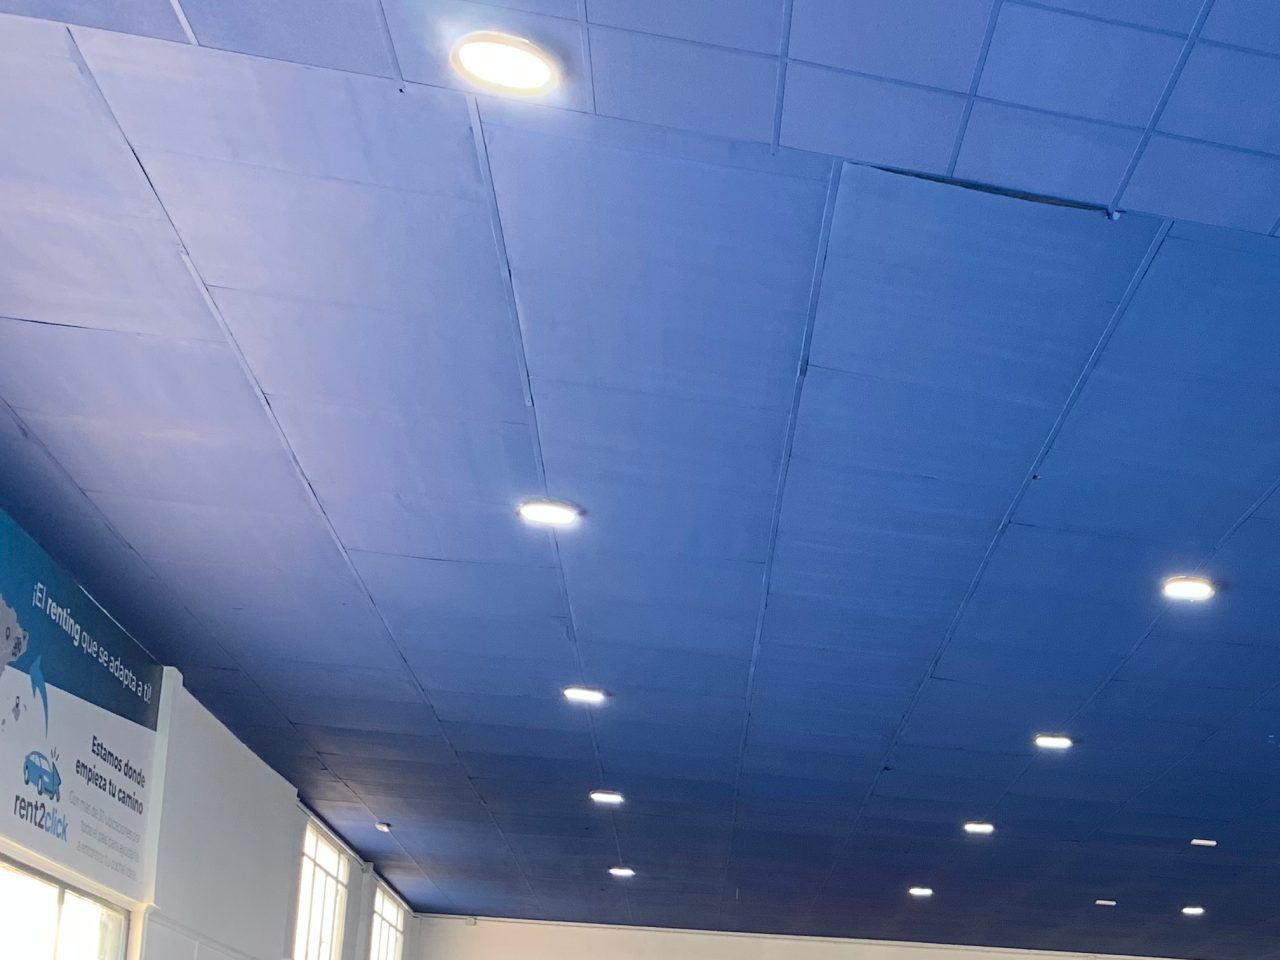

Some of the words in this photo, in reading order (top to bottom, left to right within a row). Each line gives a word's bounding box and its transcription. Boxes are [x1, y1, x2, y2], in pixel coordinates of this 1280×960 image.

[32, 582, 47, 609] ¡El
[46, 598, 81, 646] renting
[81, 631, 98, 658] que
[98, 647, 109, 666] se
[109, 657, 137, 692] adapta
[137, 681, 143, 696] a
[75, 759, 107, 792] empieza
[108, 779, 117, 798] tu
[117, 788, 144, 815] camino
[91, 734, 123, 772] Estamos
[123, 759, 146, 788] donde
[13, 794, 69, 842] rent2click
